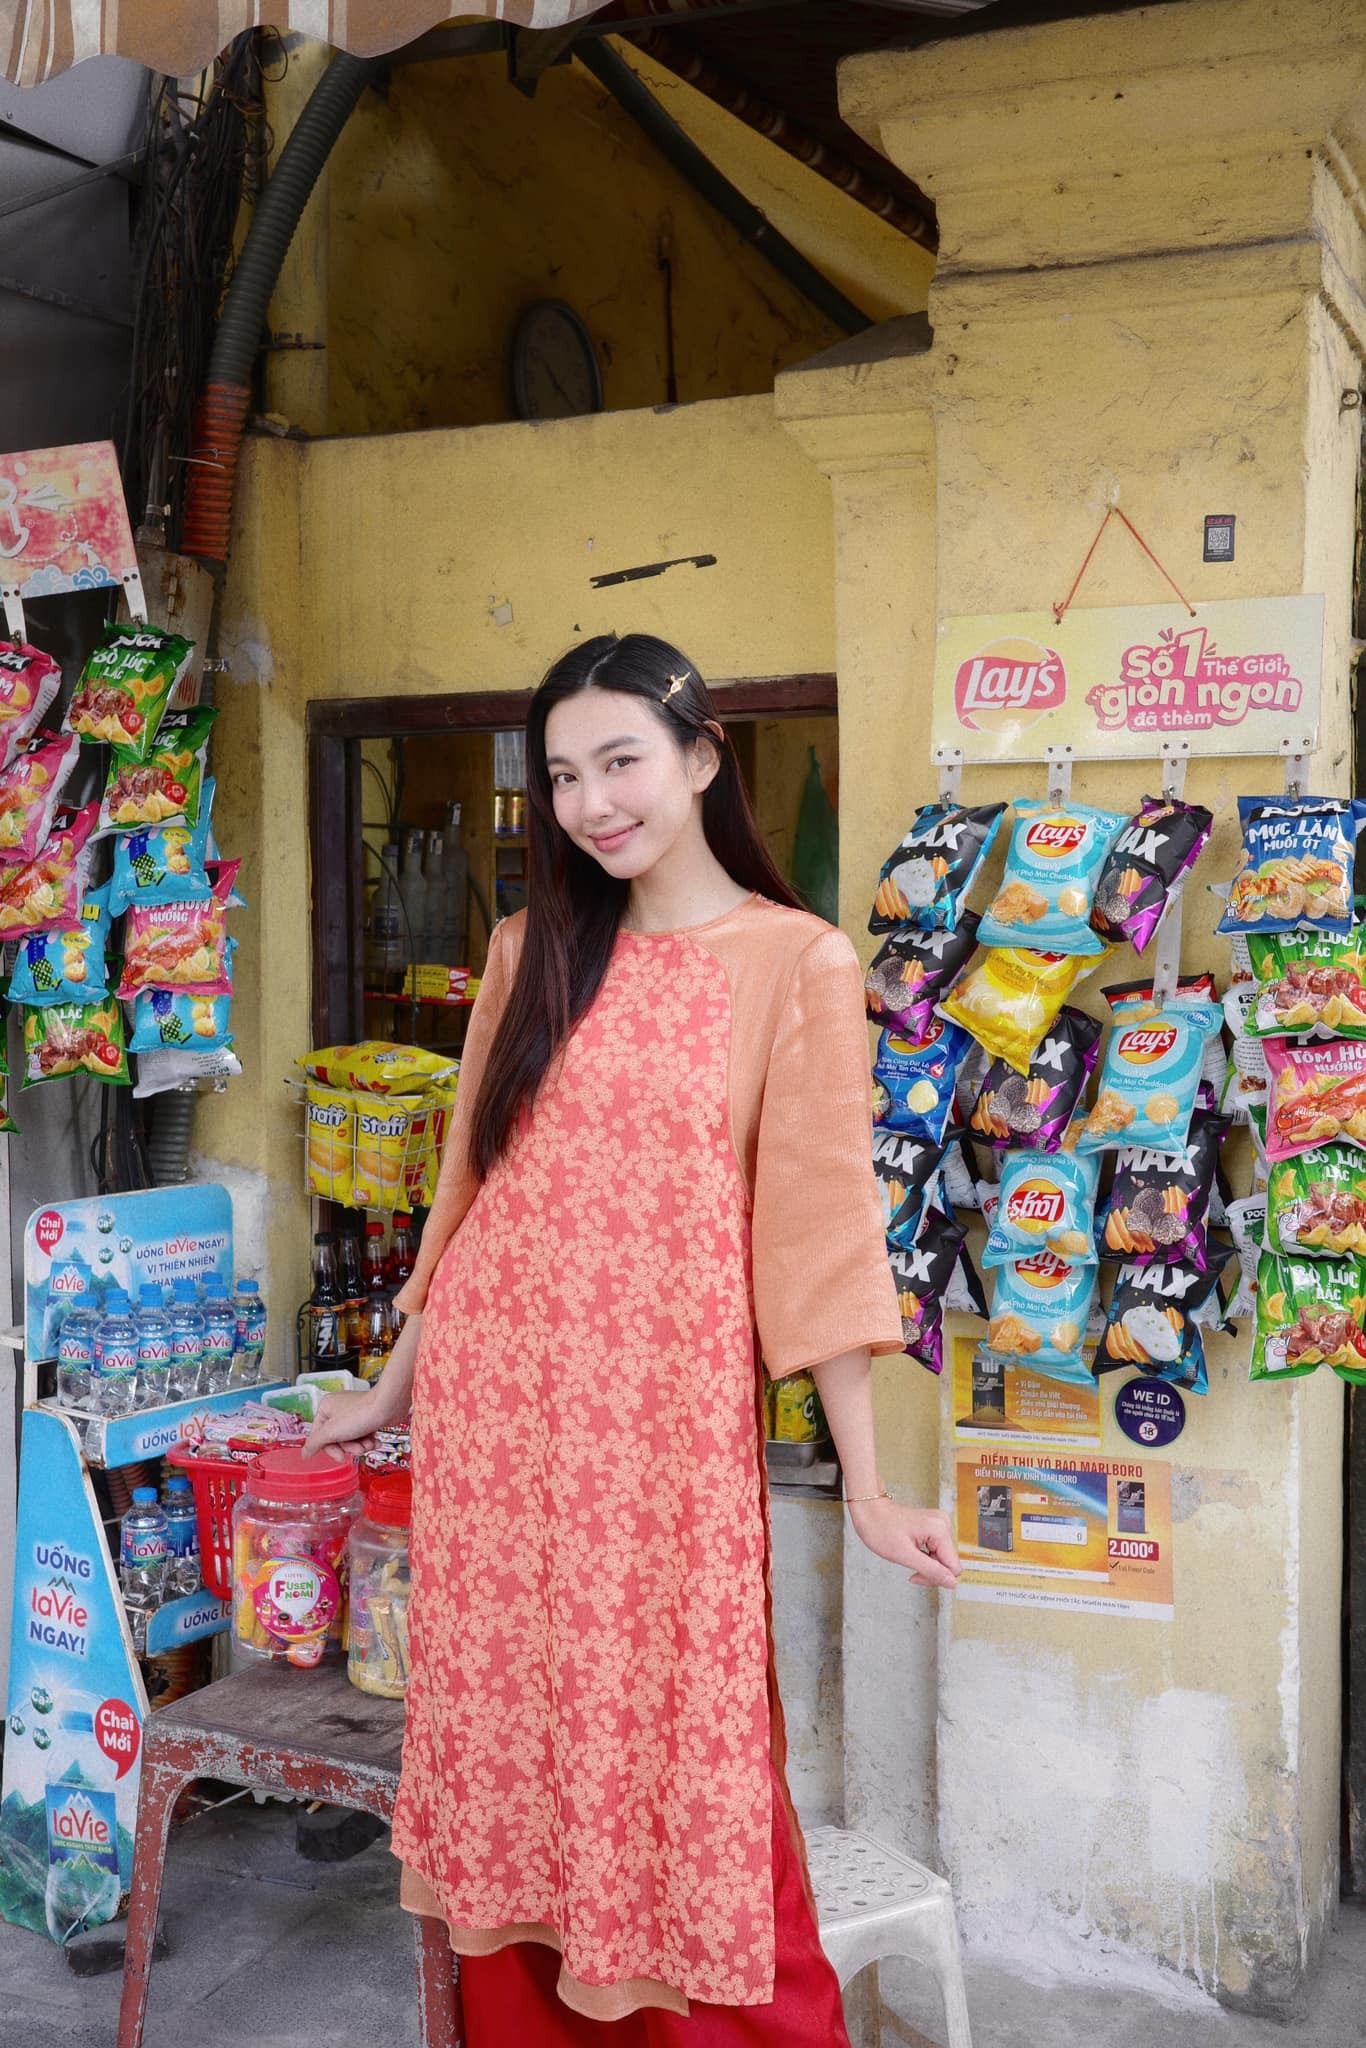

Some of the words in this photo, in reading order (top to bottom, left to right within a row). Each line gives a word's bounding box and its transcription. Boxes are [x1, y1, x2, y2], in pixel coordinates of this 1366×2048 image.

[121, 653, 148, 673] LÚC
[1126, 644, 1174, 679] Số
[1180, 627, 1207, 678] 1
[1204, 657, 1239, 677] Thế
[1243, 655, 1289, 676] Giới,
[962, 659, 1059, 710] Lay's
[1101, 679, 1186, 728] giòn
[1198, 679, 1301, 721] ngon
[1133, 709, 1158, 727] đã
[1162, 709, 1212, 727] thèm
[902, 823, 967, 850] AX
[1029, 823, 1084, 848] Lay's
[1297, 818, 1338, 841] LĂN
[1264, 833, 1298, 851] MUỐI
[1120, 1030, 1175, 1055] Lay's
[361, 1114, 408, 1136] Staff
[1115, 1145, 1200, 1176] MAX
[1010, 1190, 1062, 1221] Lay's
[39, 1217, 61, 1229] Chai
[136, 1245, 164, 1260] UỐNG
[165, 1237, 197, 1256] laVie
[198, 1238, 225, 1250] NGAY!
[147, 1264, 157, 1275] VỊ
[1327, 1264, 1359, 1289] LÚC
[52, 1274, 85, 1291] laVie
[1117, 1264, 1200, 1299] MAX
[60, 1345, 90, 1359] aVie
[202, 1335, 232, 1348] aVie
[102, 1353, 136, 1367] laVie
[1133, 1389, 1154, 1403] WE
[1157, 1394, 1171, 1405] ID
[142, 1428, 178, 1450] UỐNG
[180, 1414, 209, 1439] laV
[1143, 1427, 1154, 1436] 18
[1040, 1471, 1078, 1484] MARLBORO
[1080, 1461, 1143, 1478] MARLBORO
[37, 1545, 90, 1578] UỐNG
[275, 1580, 314, 1598] FUSEN
[285, 1591, 313, 1599] NOMI
[32, 1586, 88, 1628] laVie
[184, 1607, 219, 1629] UỐNG
[30, 1620, 85, 1655] NGAY!
[100, 1708, 135, 1731] Chai
[103, 1731, 132, 1753] Mới
[53, 1807, 109, 1842] laVie
